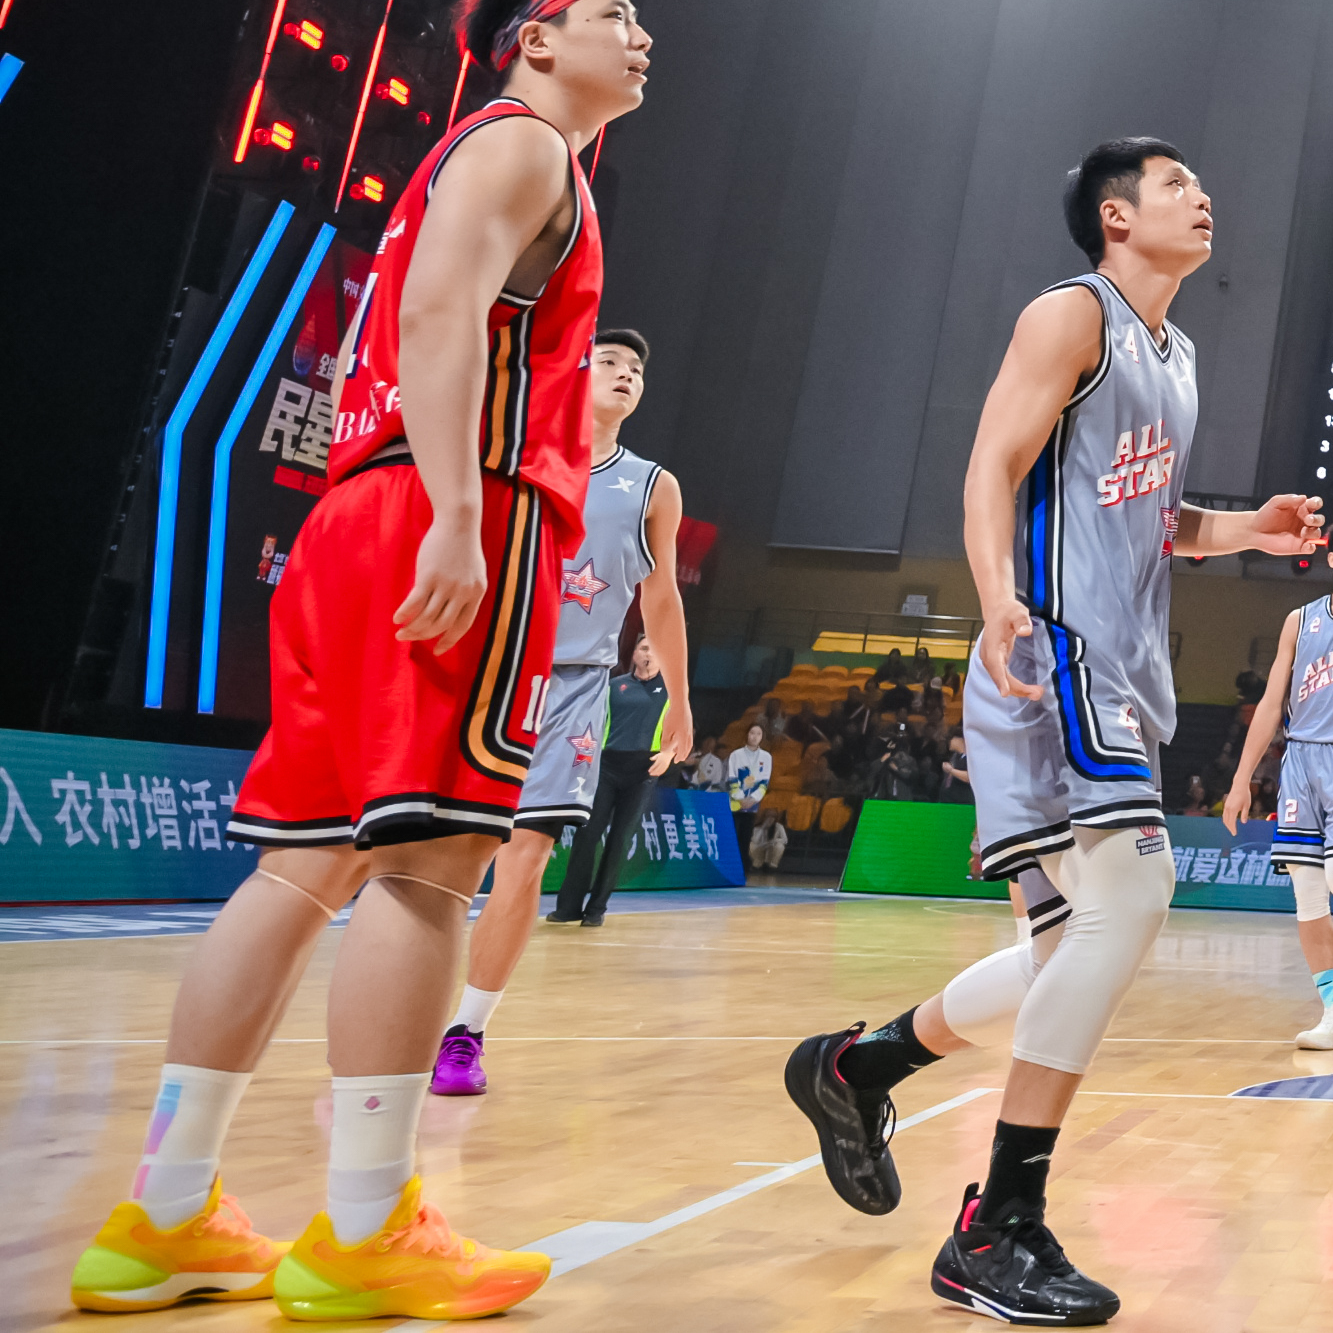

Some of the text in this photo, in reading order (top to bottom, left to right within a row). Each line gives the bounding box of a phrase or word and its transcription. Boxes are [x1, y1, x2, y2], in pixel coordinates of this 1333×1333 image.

[1124, 328, 1139, 363] 4
[1111, 418, 1171, 468] ALL
[1320, 440, 1330, 452] 3
[1097, 450, 1176, 507] STAR
[1310, 617, 1320, 633] 2
[1285, 798, 1298, 823] 2
